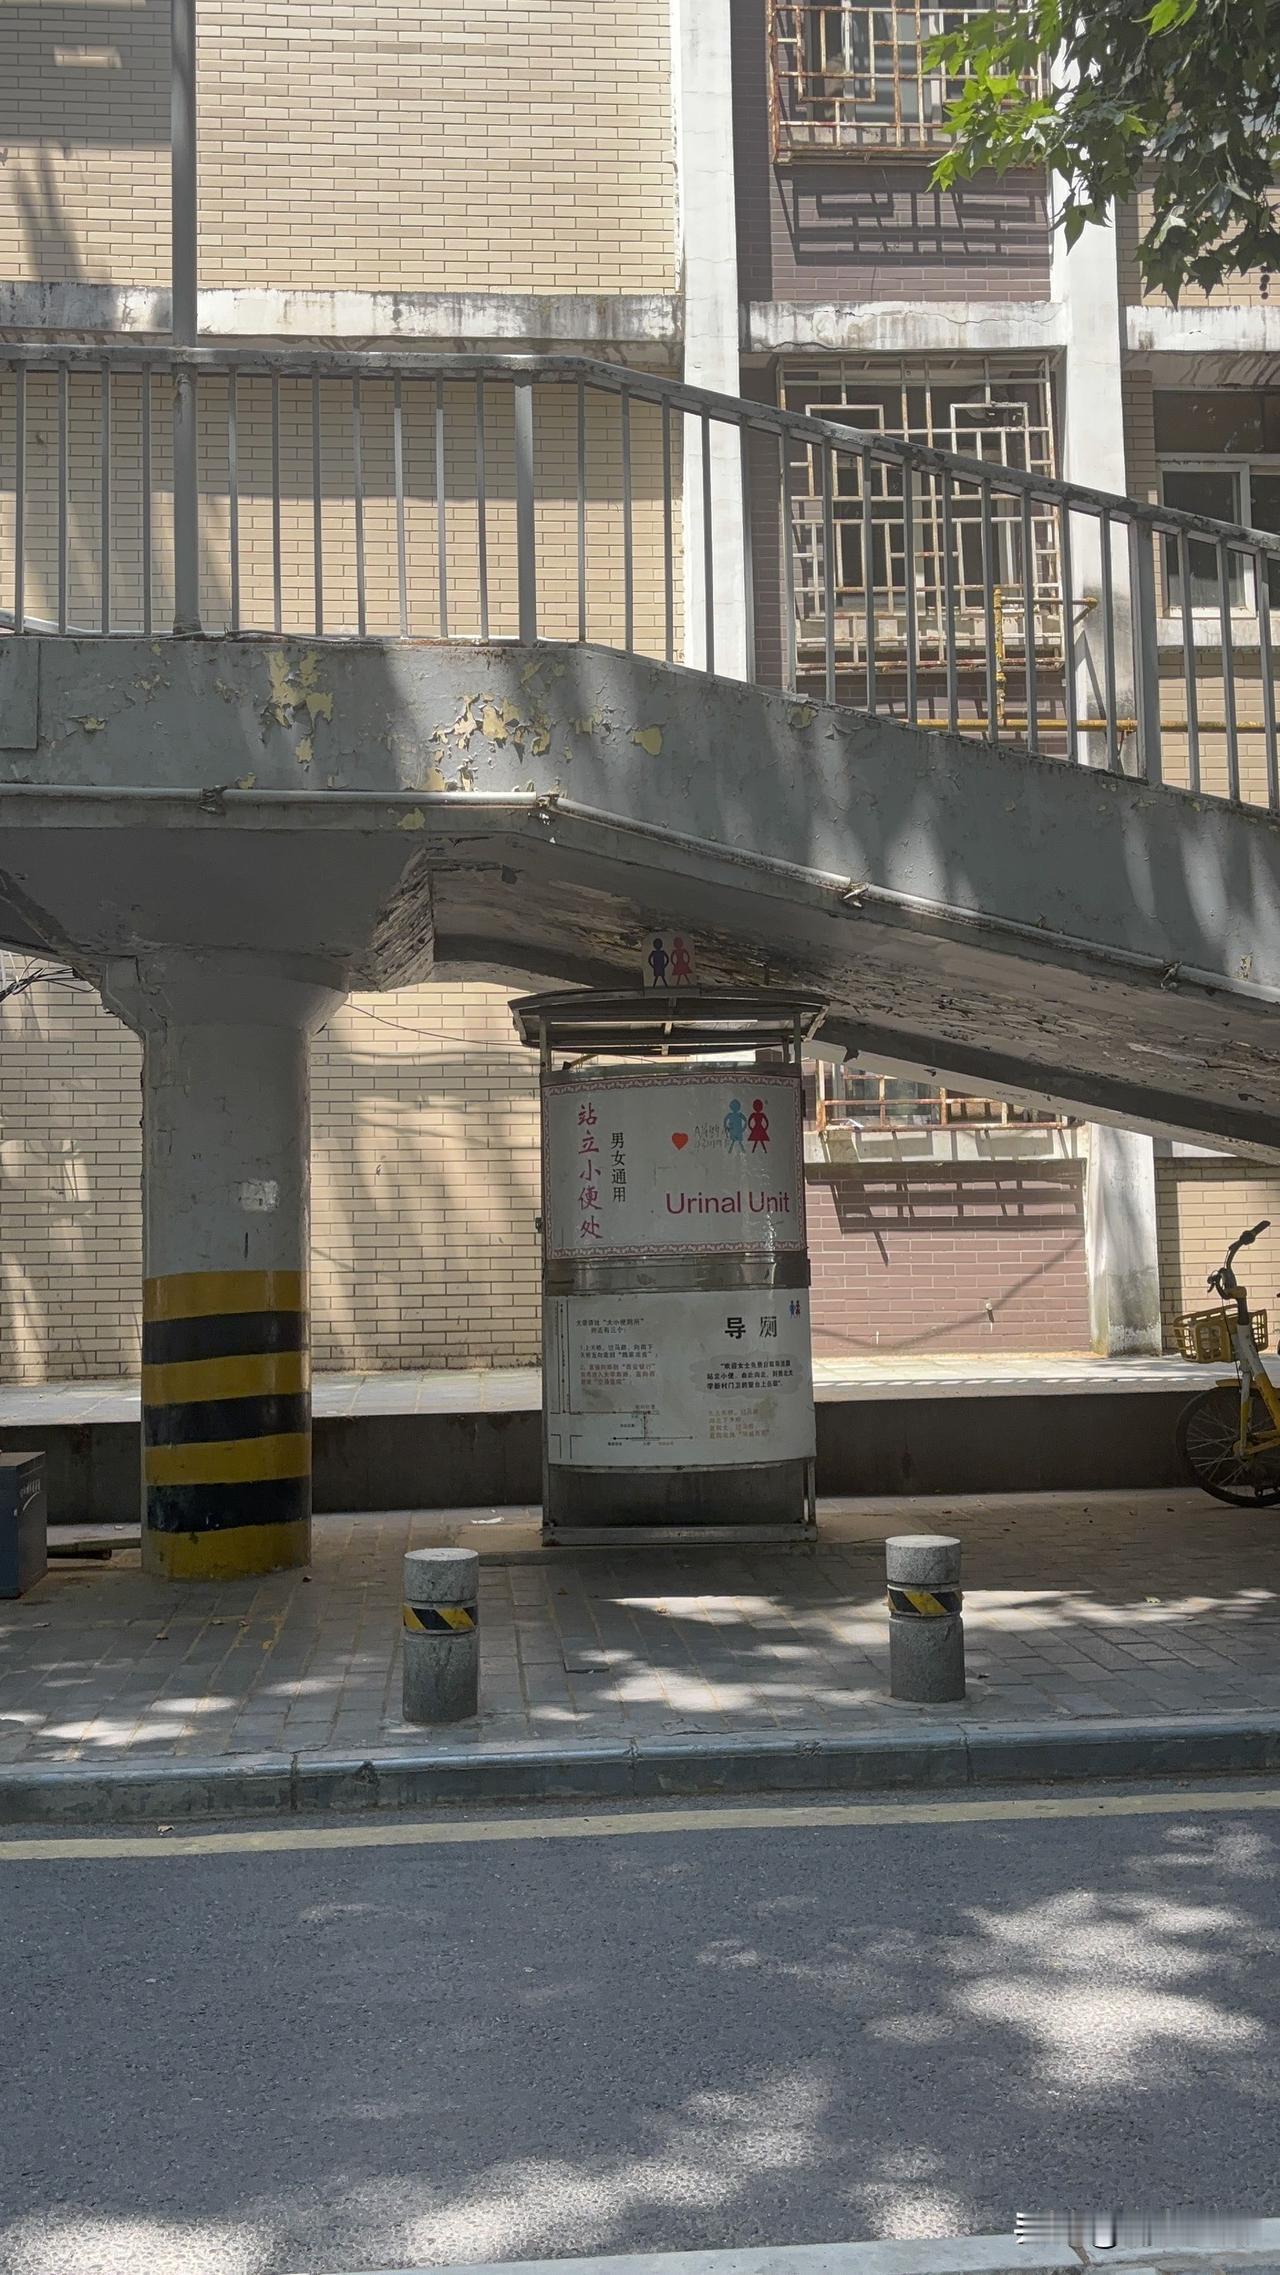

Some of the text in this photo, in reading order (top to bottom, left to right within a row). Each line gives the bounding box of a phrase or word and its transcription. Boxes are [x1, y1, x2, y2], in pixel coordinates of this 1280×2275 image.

[577, 1102, 604, 1239] 站立小便处
[610, 1132, 627, 1203] 男女通用
[666, 1191, 790, 1214] Urinal Unit
